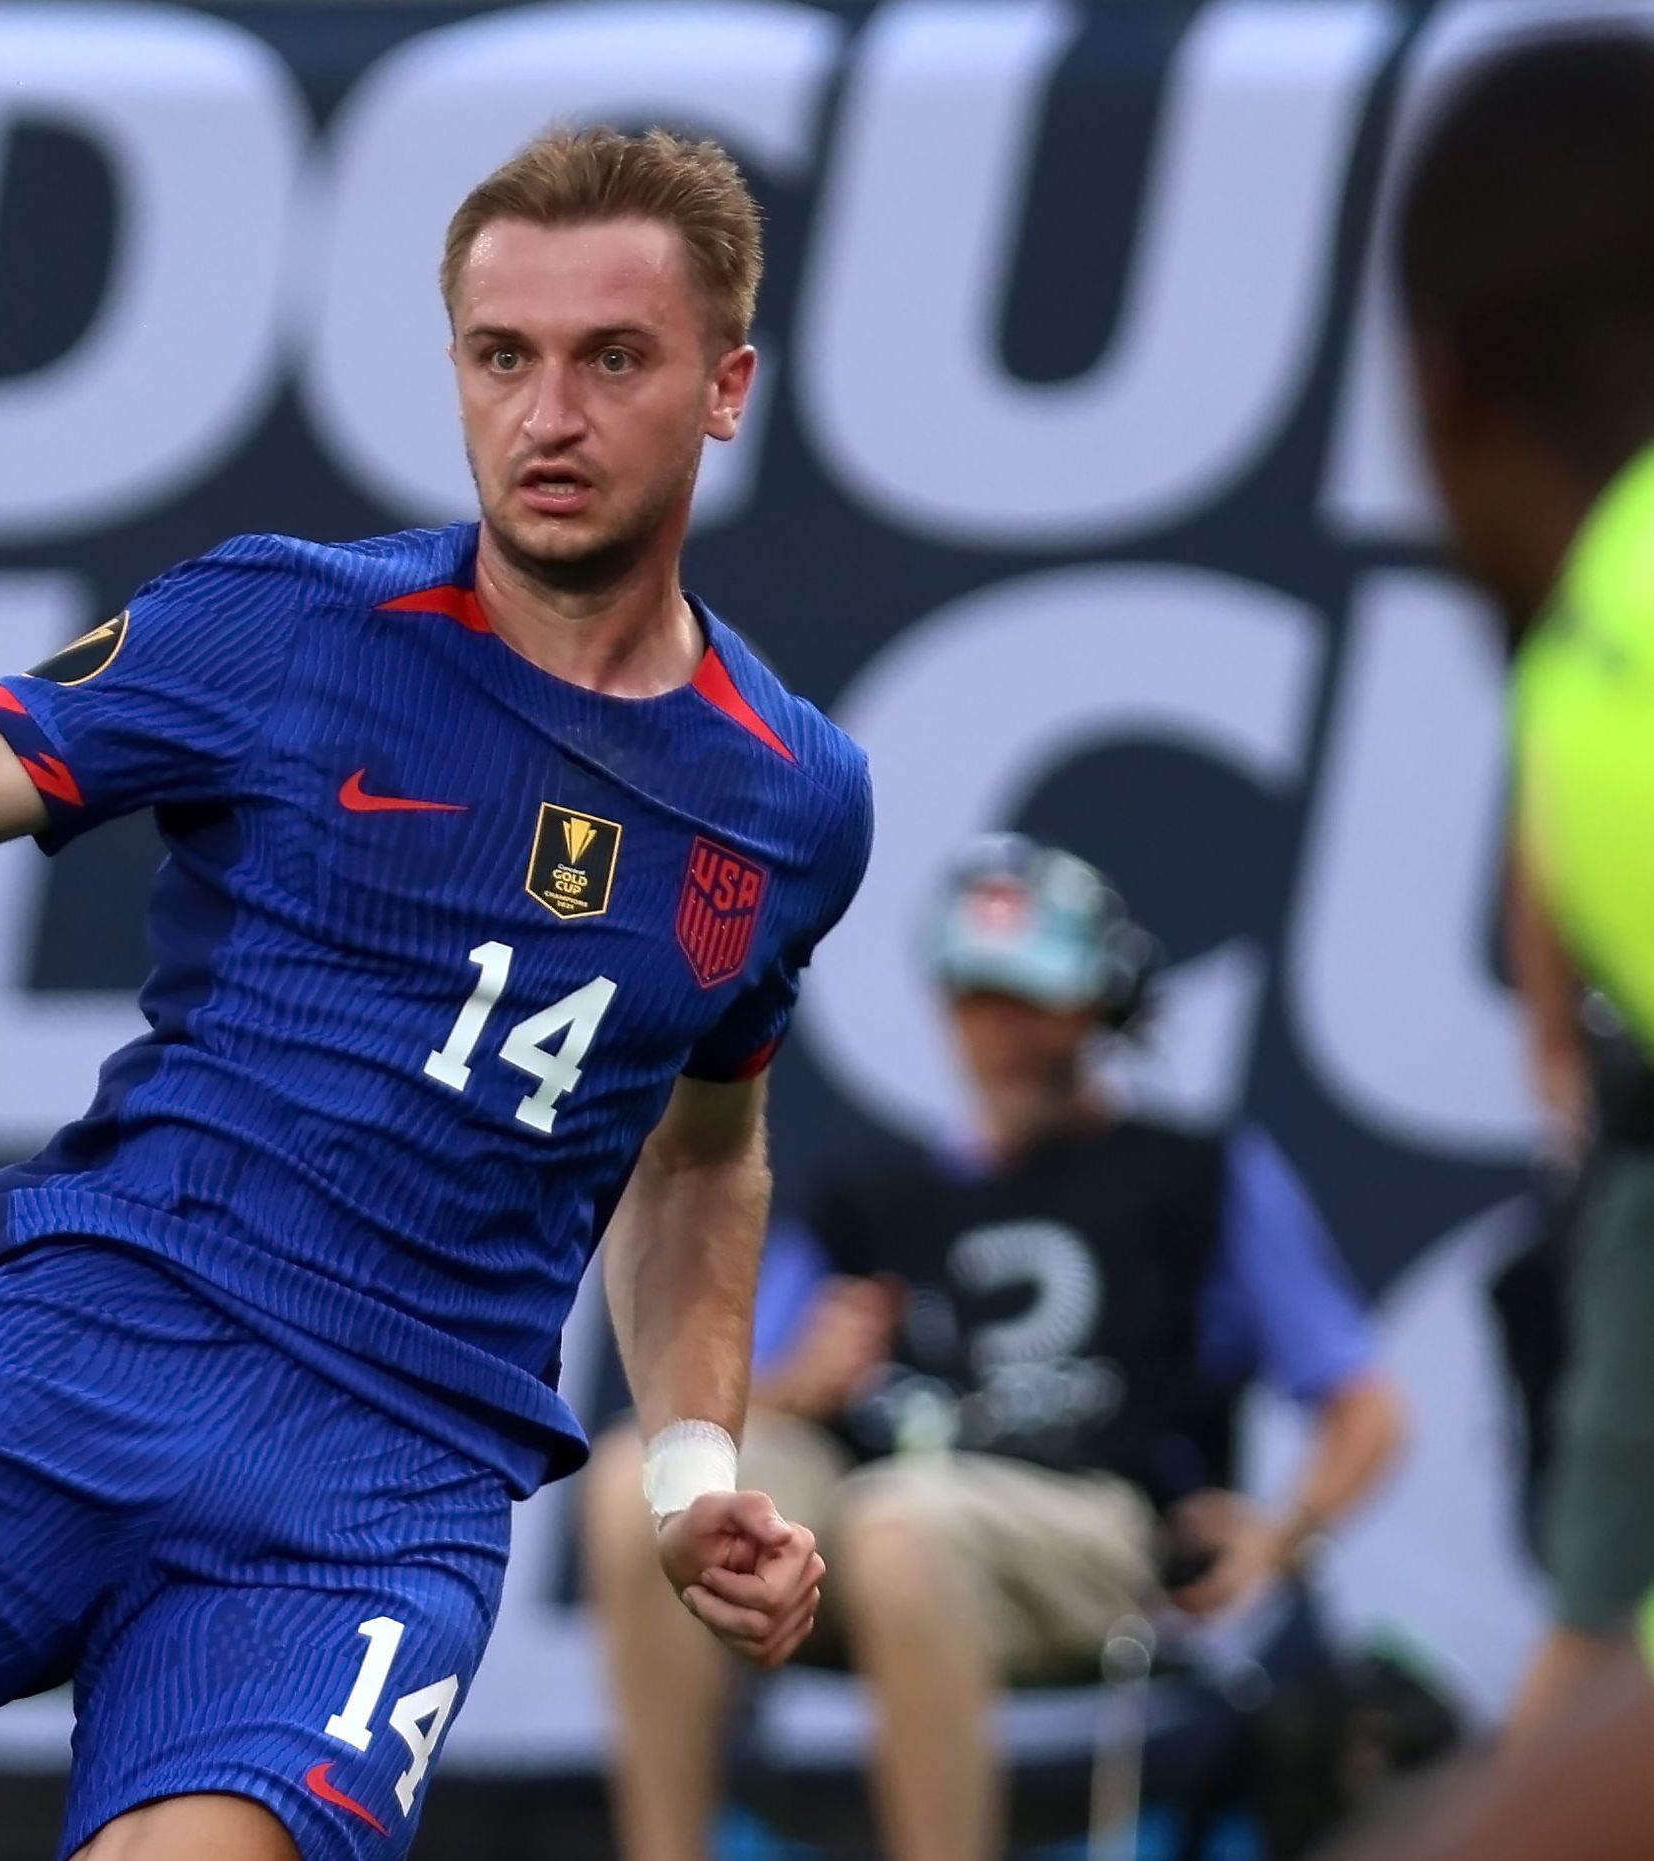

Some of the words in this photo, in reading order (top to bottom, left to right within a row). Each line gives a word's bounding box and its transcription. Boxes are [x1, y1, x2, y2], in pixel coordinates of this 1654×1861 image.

[552, 869, 588, 887] GOLD
[555, 880, 582, 895] CUP
[694, 848, 761, 912] USA
[423, 940, 618, 1134] 14
[324, 1615, 460, 1818] 14
